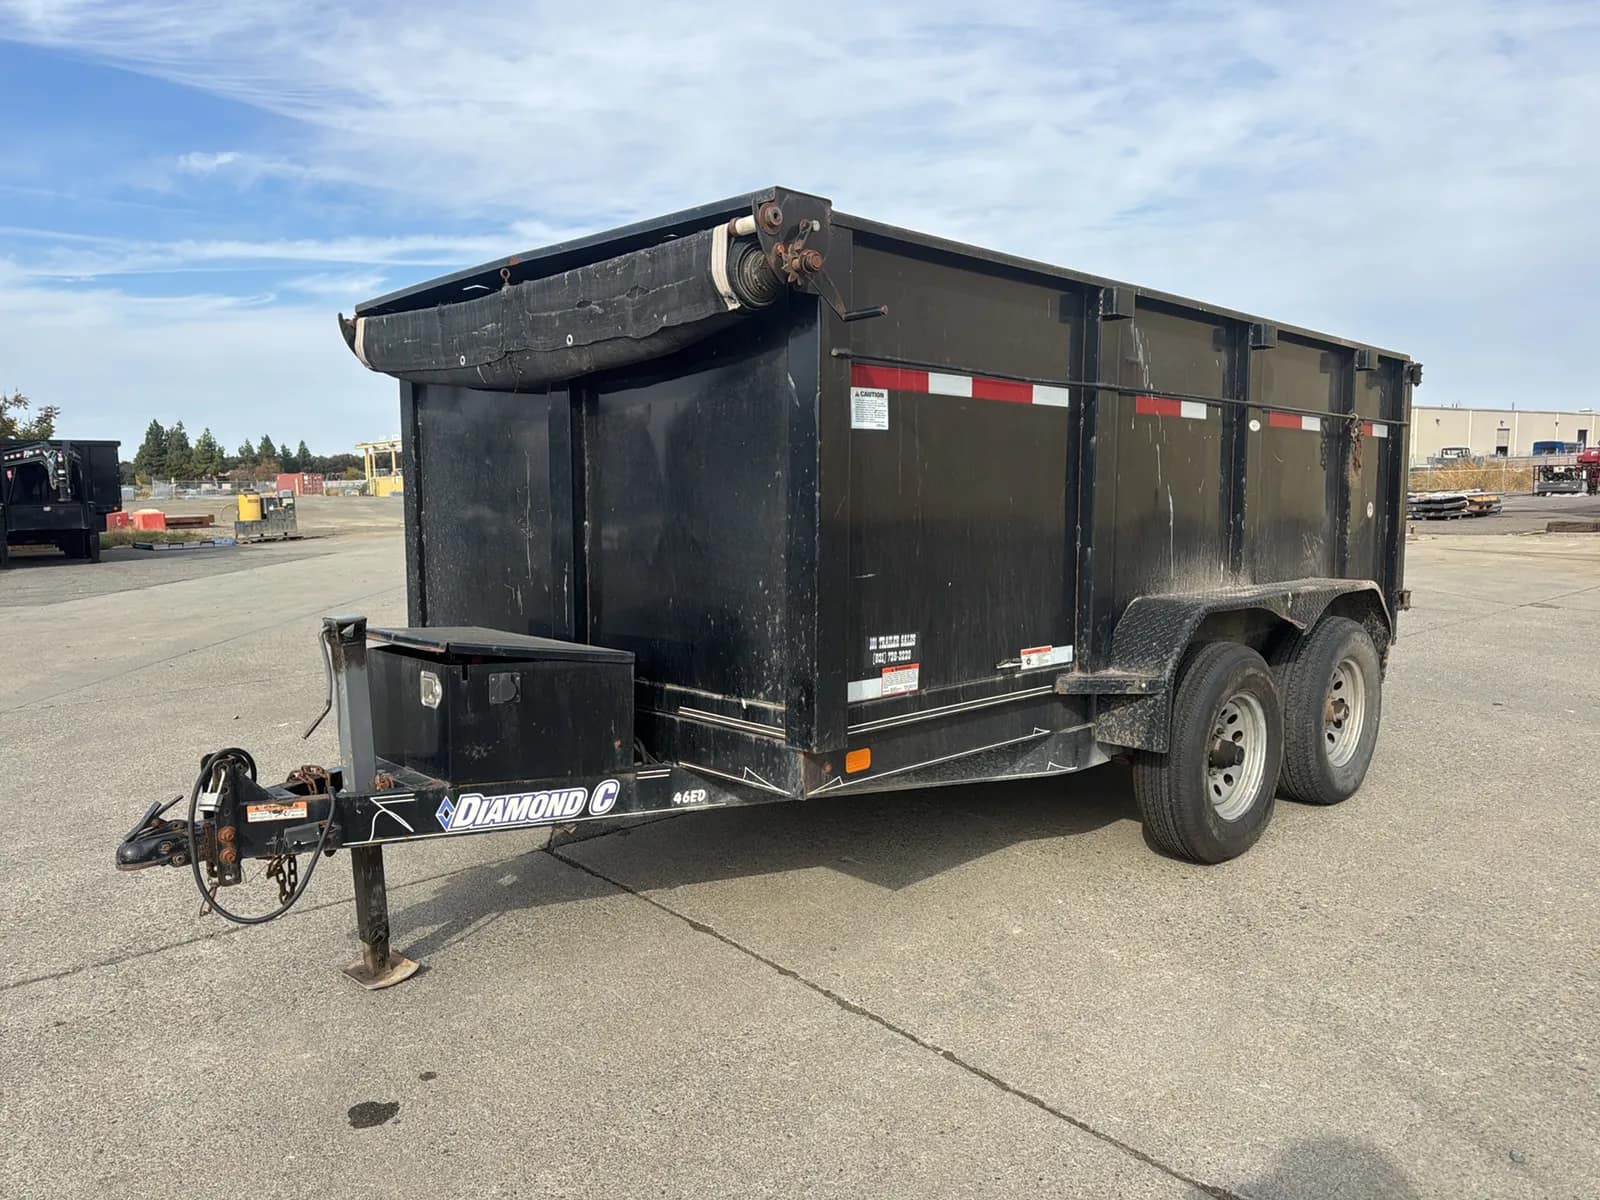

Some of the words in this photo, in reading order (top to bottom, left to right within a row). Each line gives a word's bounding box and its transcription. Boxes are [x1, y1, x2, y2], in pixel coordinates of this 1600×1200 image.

[451, 788, 588, 829] DIAMOND
[590, 779, 620, 816] C
[673, 789, 706, 804] 46ED
